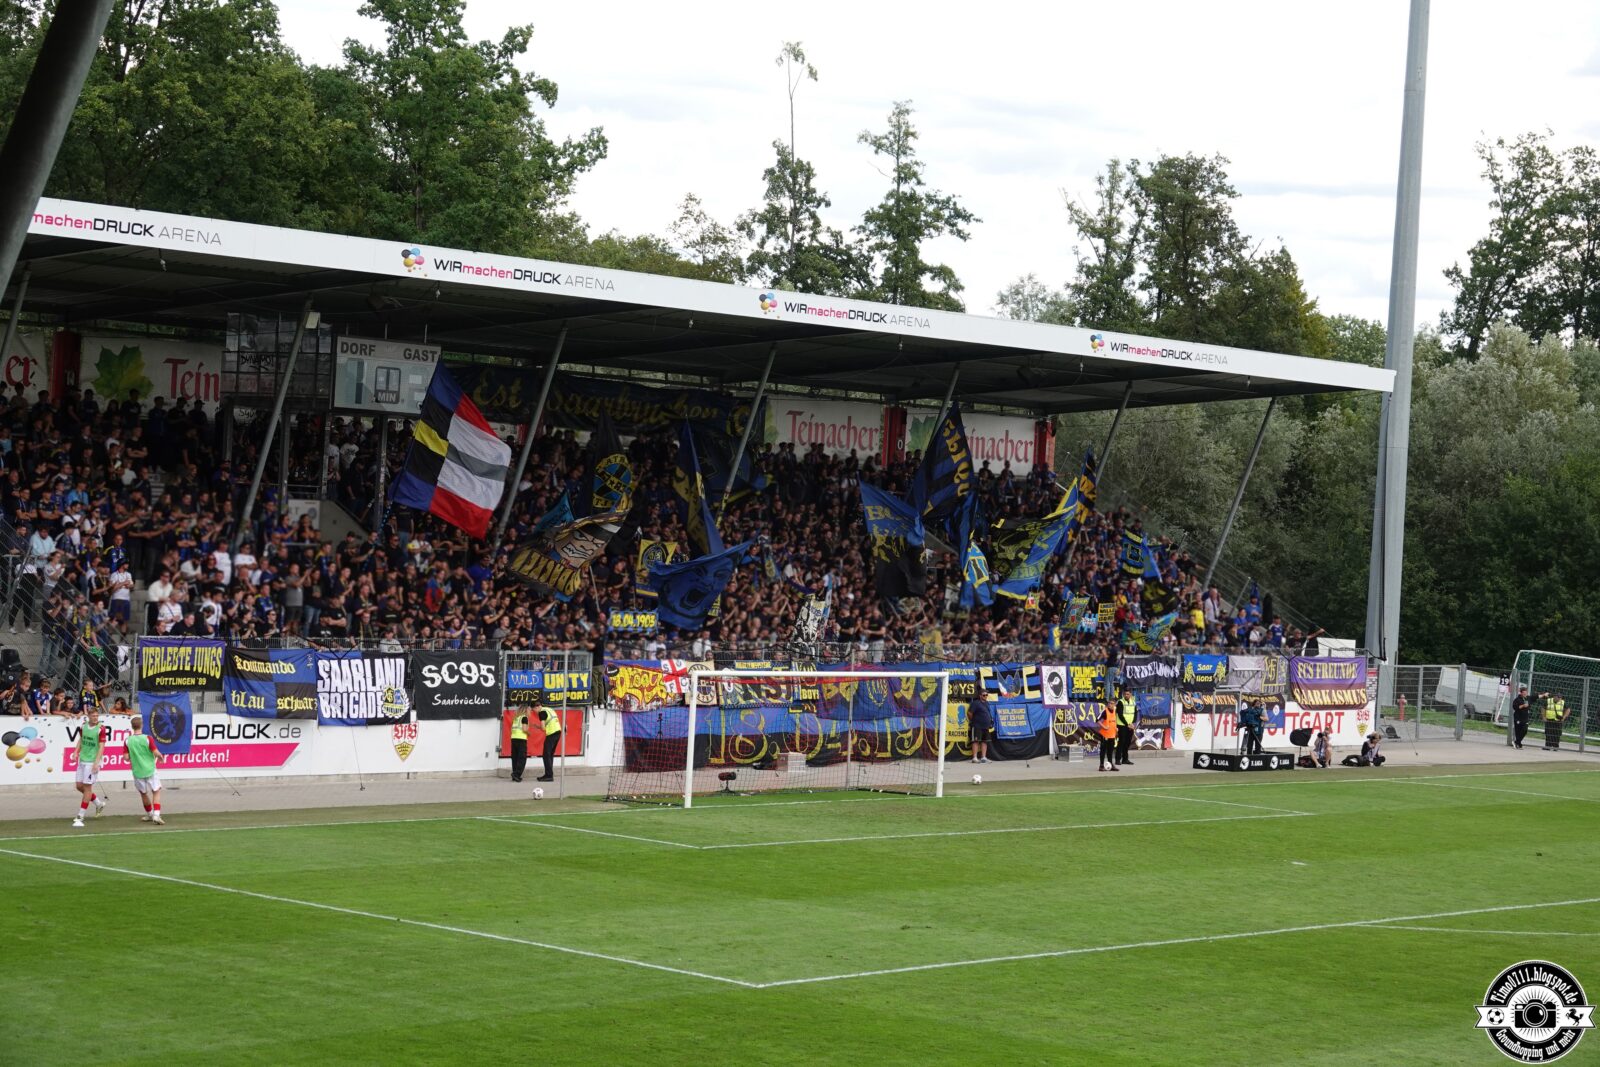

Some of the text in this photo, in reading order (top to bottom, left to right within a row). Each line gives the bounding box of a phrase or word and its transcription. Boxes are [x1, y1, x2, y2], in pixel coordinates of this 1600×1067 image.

[158, 226, 221, 245] ARENA
[434, 258, 615, 291] WIRmachenDRUCK ARENA
[784, 301, 931, 328] WIRmachenDRUCK ARENA
[340, 342, 438, 362] DORF GAST
[1110, 341, 1228, 365] WIRmachenDRUCK ARENA
[377, 392, 396, 402] MIN
[786, 410, 879, 450] Teinacher
[611, 613, 656, 628] 18.04.1903
[142, 646, 223, 679] VERLEBTE JUNGS
[1069, 665, 1096, 678] YOUNG
[1197, 663, 1214, 671] Saar
[1297, 662, 1358, 680] FCS FREUNDE
[155, 677, 195, 686] PÜTTLINGEN
[317, 657, 406, 692] SAARLAND
[421, 661, 496, 688] SC95
[511, 674, 540, 686] WILD
[1072, 677, 1093, 689] SIDE
[319, 691, 385, 719] BRIGADE
[431, 693, 491, 706] Saarbrücken
[510, 690, 540, 701] CATS
[1294, 687, 1367, 707] SAARKASMUS
